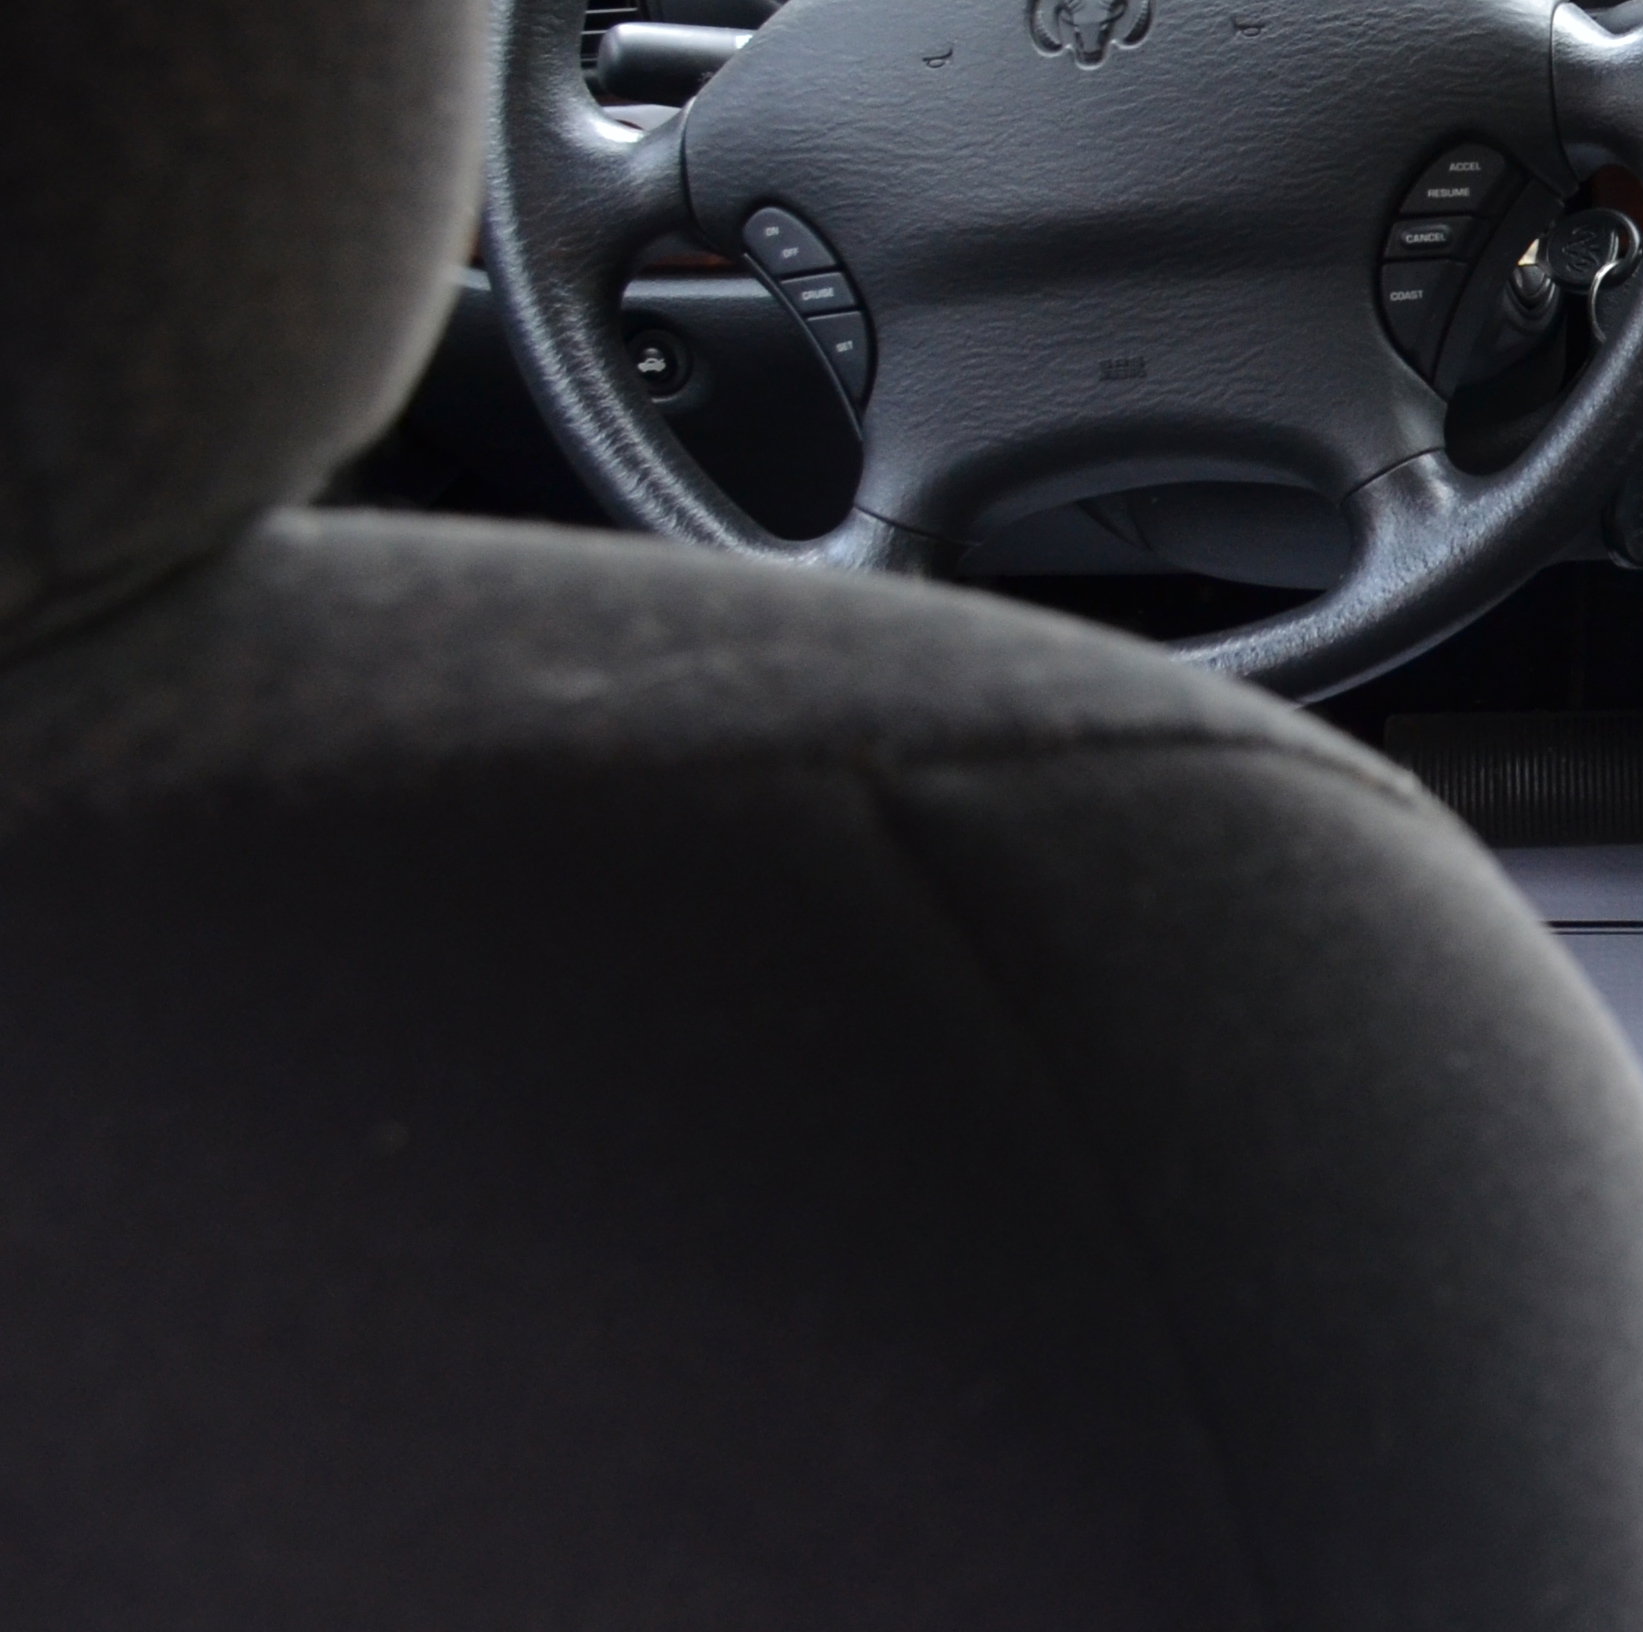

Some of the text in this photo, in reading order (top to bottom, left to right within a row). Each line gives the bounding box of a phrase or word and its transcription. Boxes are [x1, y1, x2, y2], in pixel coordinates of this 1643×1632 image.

[1449, 162, 1481, 171] ACCEL
[1427, 188, 1470, 198] RESUME
[765, 226, 779, 237] ON
[1405, 233, 1446, 244] CANCEL
[801, 287, 834, 301] CRUISE
[1390, 290, 1424, 301] COAST
